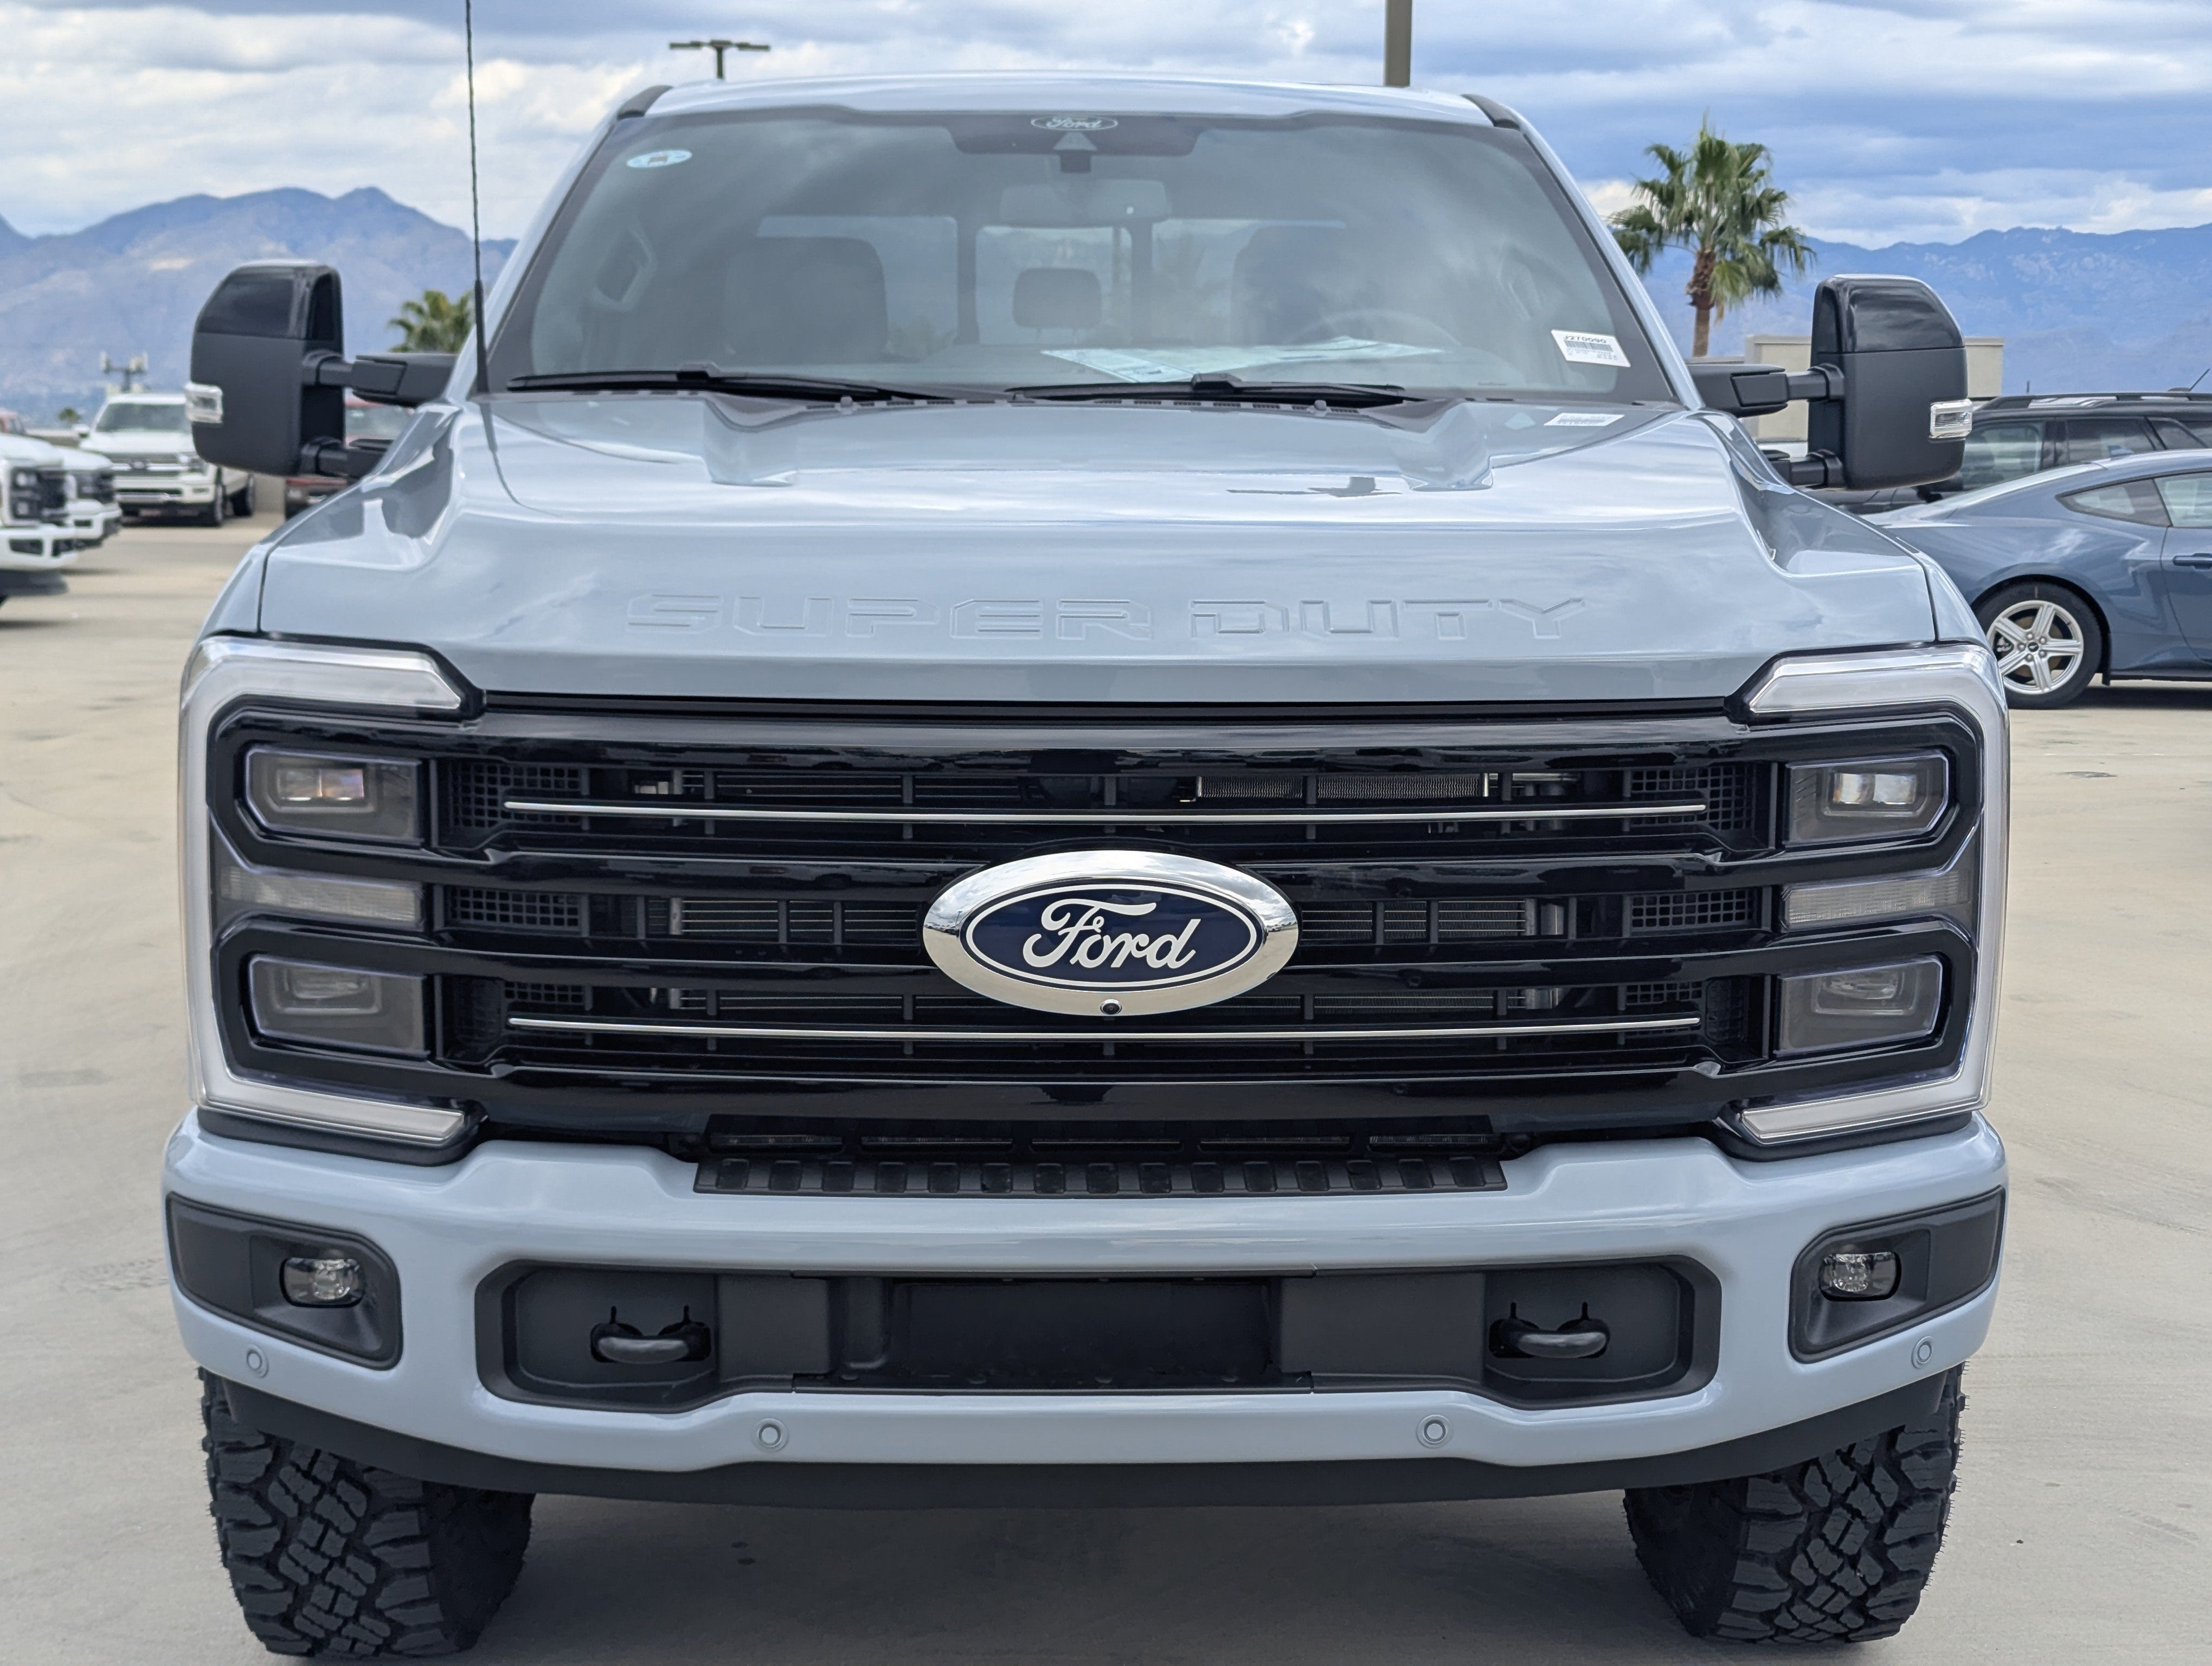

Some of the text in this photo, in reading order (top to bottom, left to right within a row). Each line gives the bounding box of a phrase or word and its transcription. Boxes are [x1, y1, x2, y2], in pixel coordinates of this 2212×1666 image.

[1046, 117, 1101, 128] Ford
[625, 593, 1586, 641] SUPER DUTY
[1023, 898, 1201, 969] Ford
